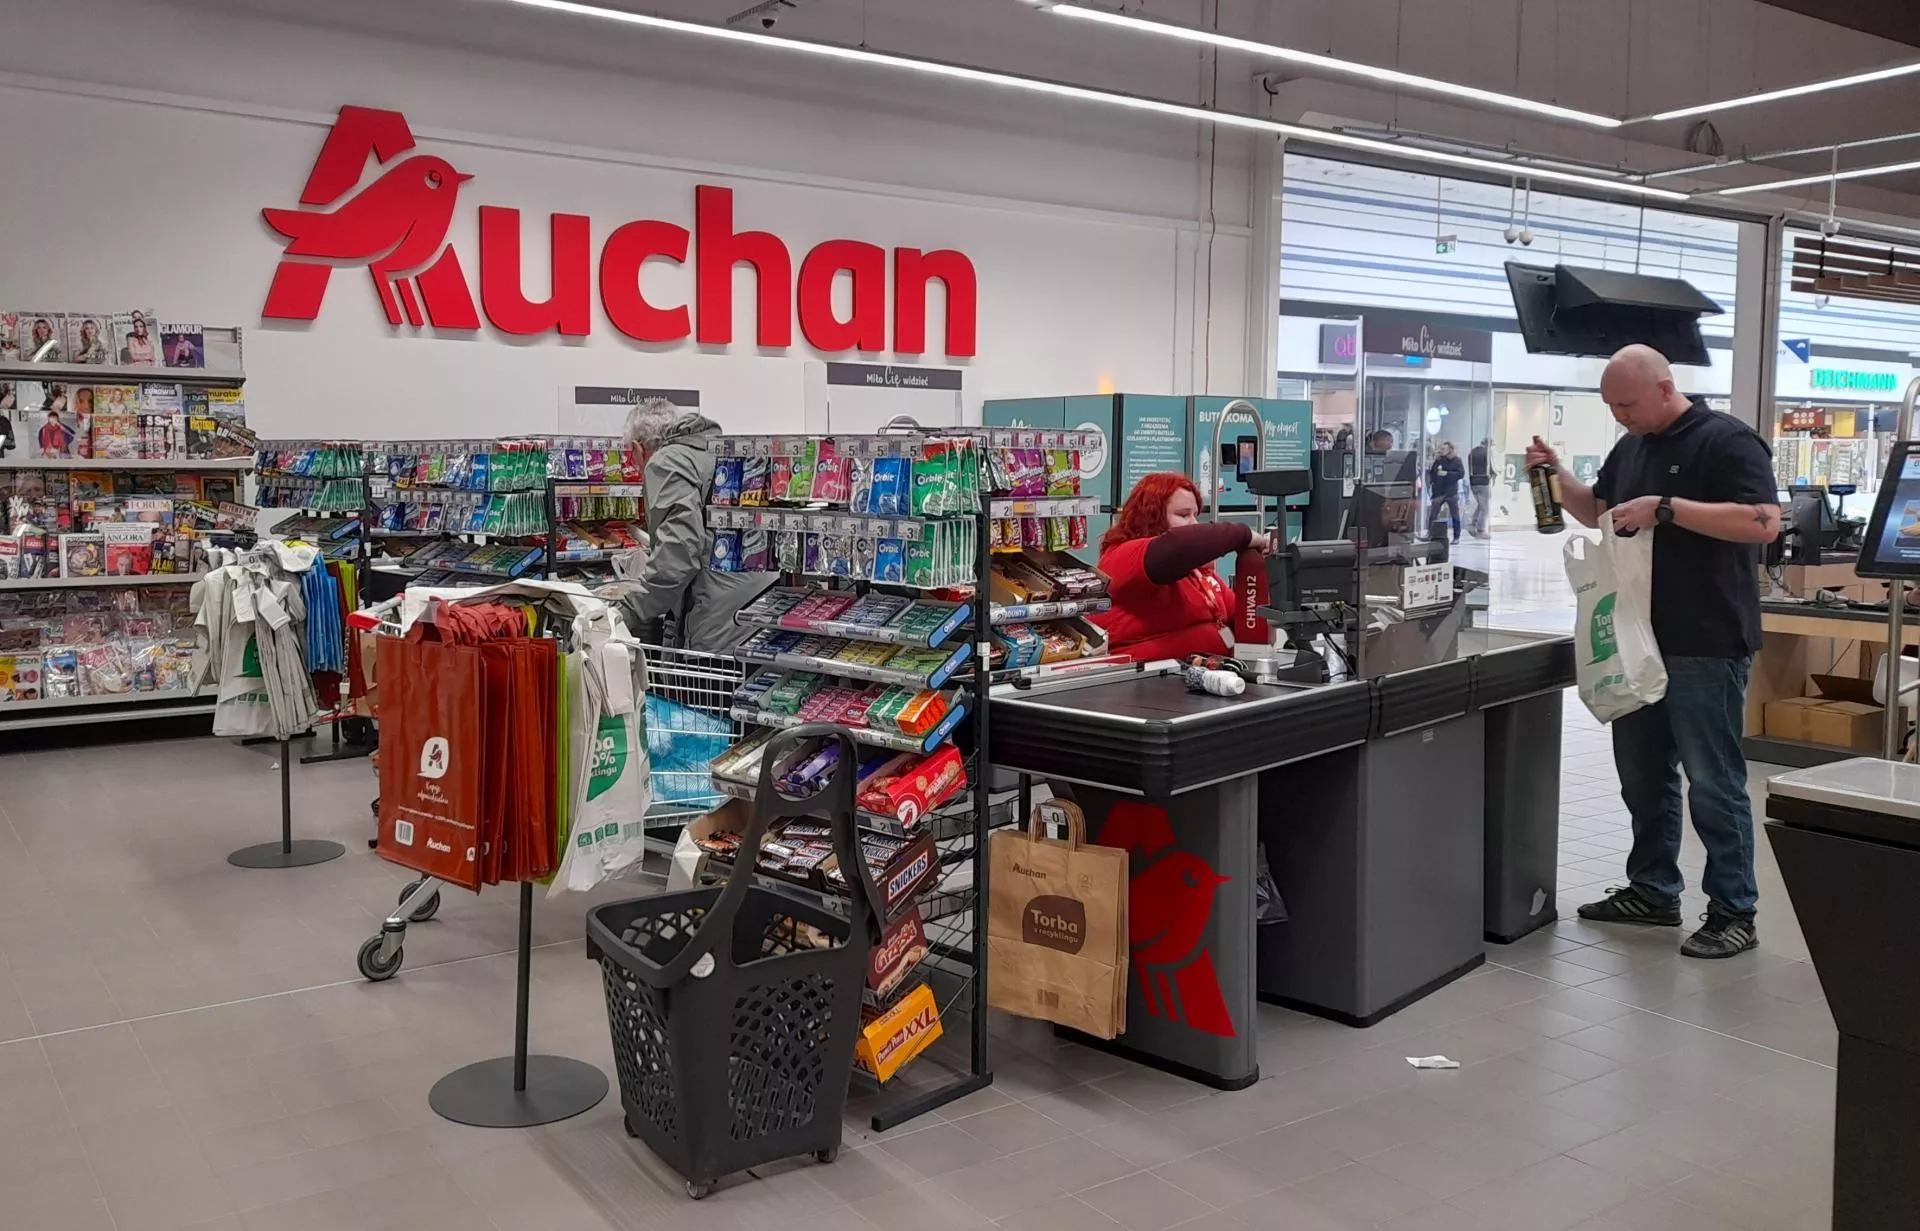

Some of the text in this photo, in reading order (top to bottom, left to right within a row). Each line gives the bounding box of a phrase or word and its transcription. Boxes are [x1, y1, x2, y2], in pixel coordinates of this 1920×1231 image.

[262, 105, 977, 358] Auchan
[160, 324, 202, 335] GLAMOUR
[873, 470, 897, 483] Orbit
[106, 533, 144, 541] ANGORA
[878, 543, 900, 555] Orbit
[907, 547, 931, 561] Orbit
[1246, 588, 1257, 629] CHIVAS
[889, 854, 928, 896] SNICKERS
[1012, 862, 1047, 880] Auchan
[1030, 908, 1079, 934] Torba
[905, 1006, 936, 1041] XXL
